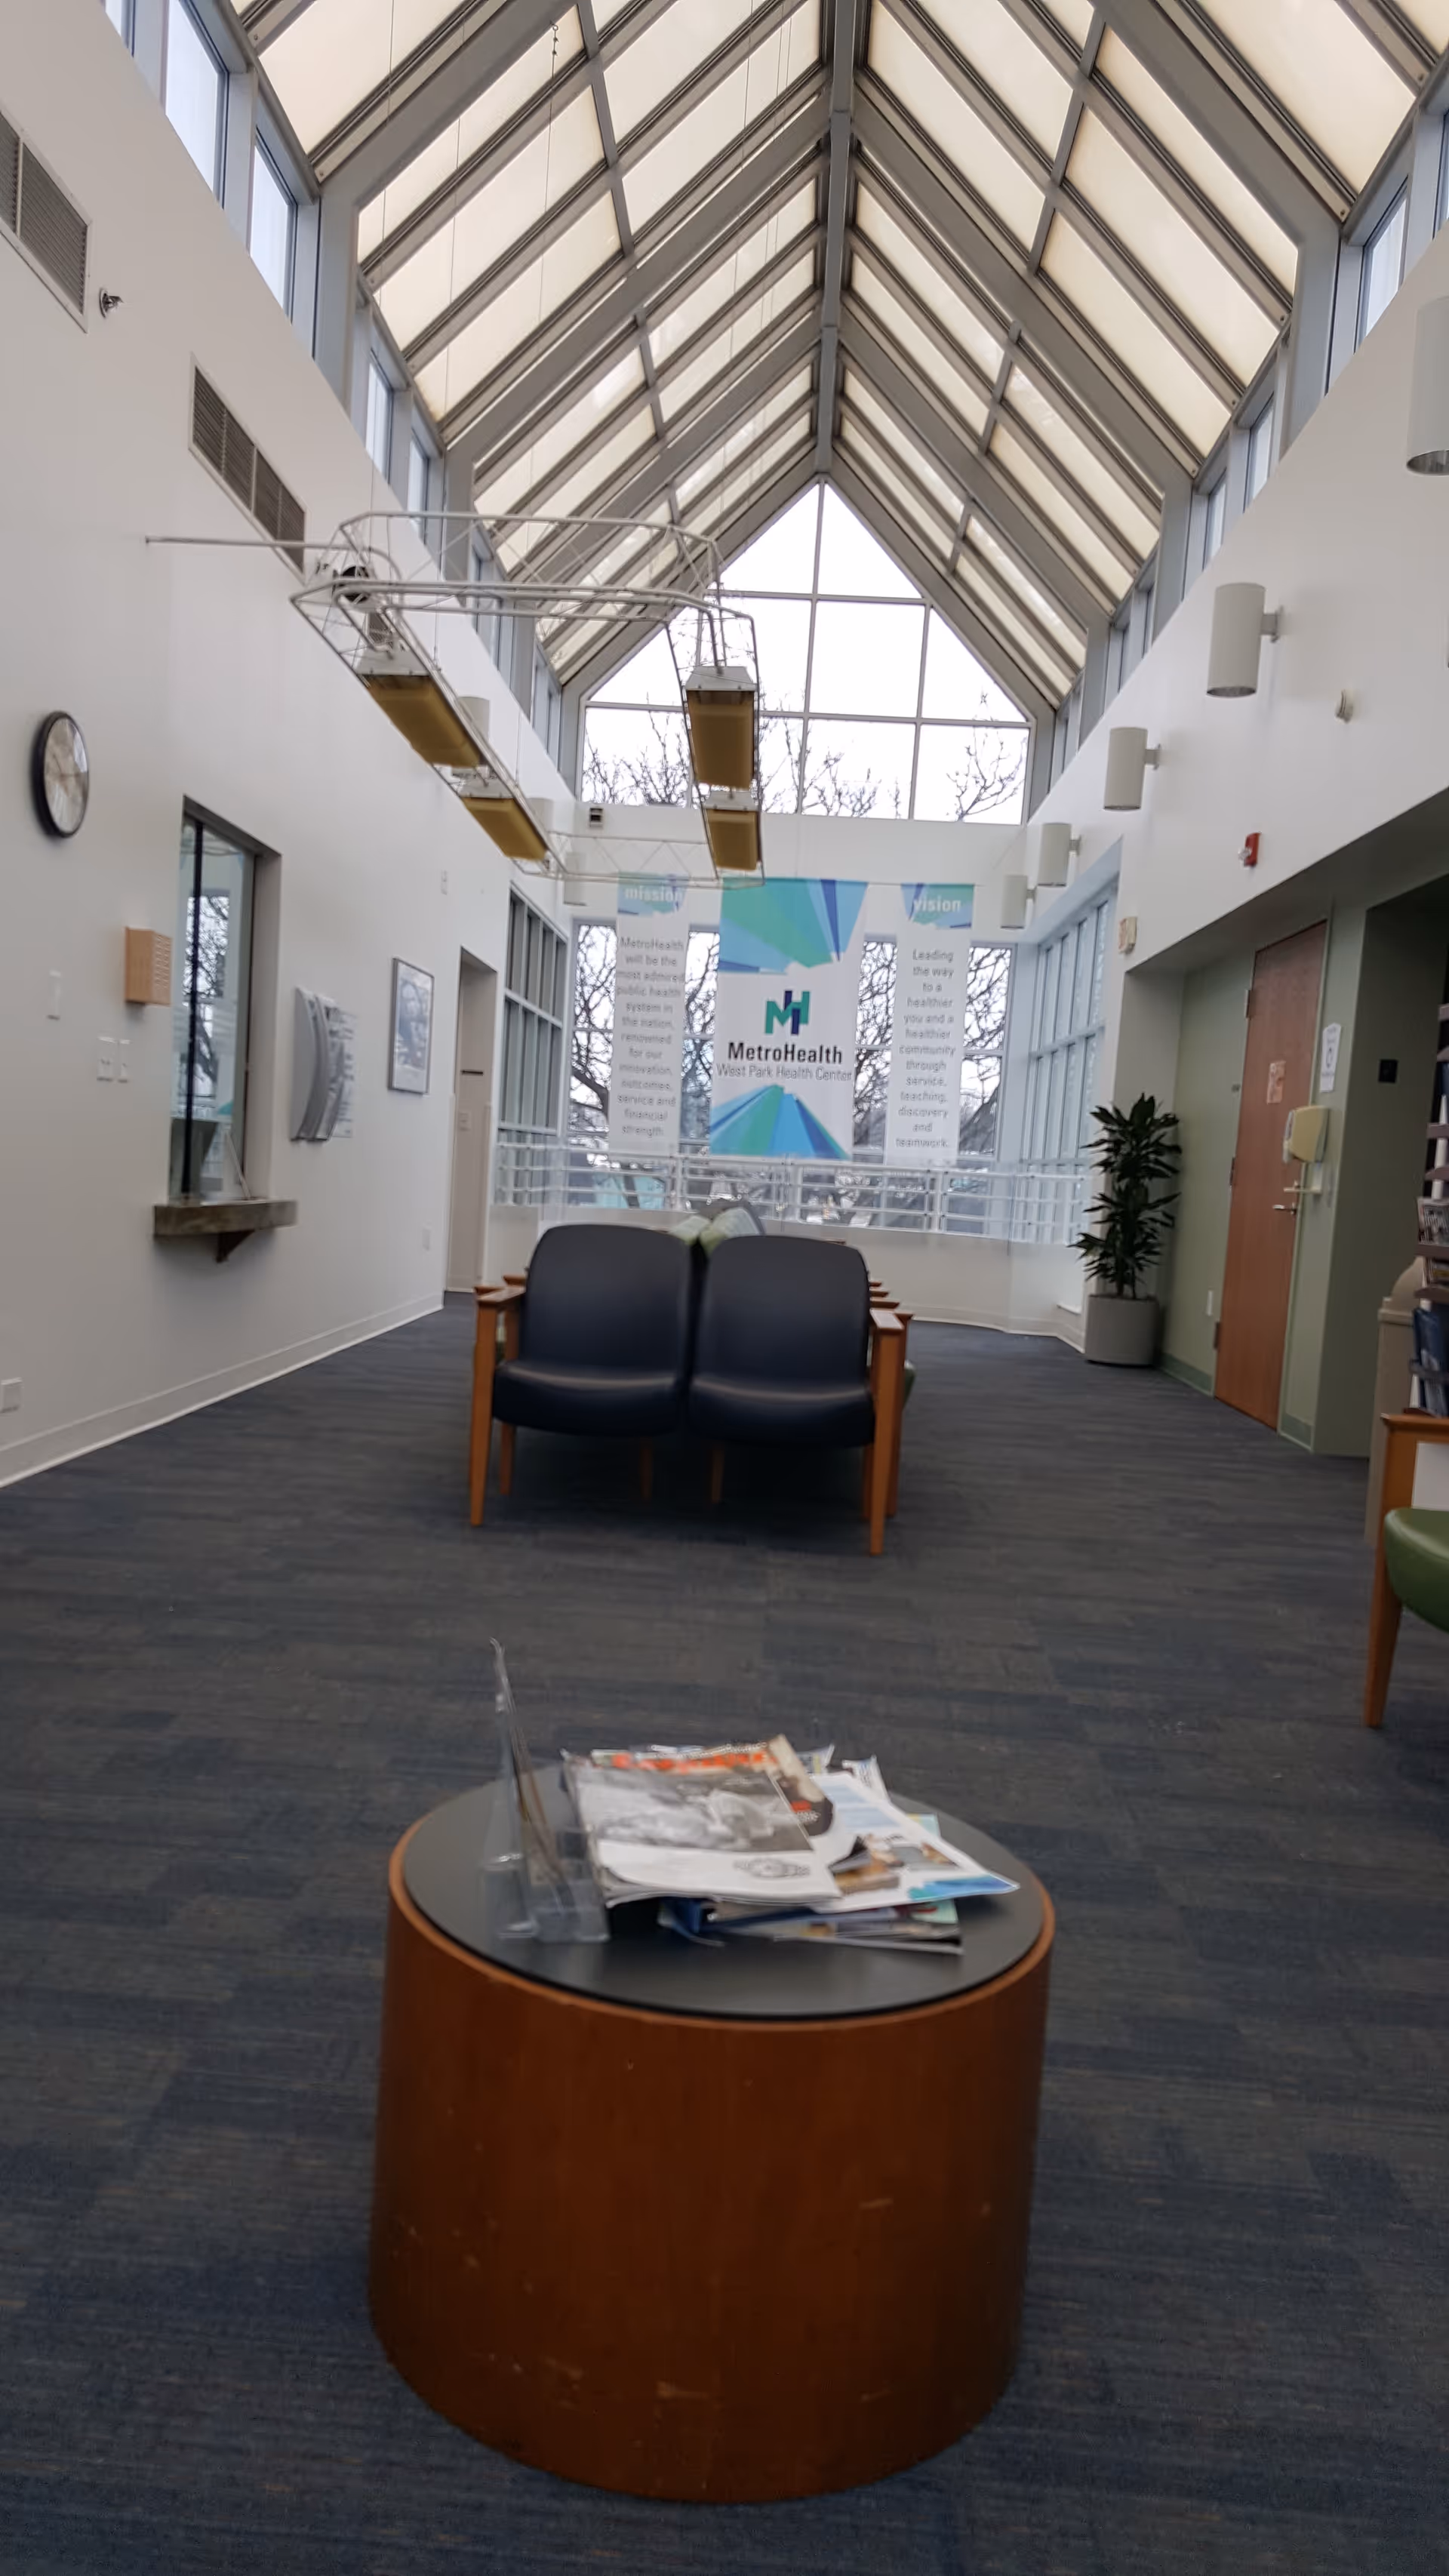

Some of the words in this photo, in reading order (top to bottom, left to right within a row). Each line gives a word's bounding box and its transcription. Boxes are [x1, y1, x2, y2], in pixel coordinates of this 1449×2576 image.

[624, 885, 683, 903] mission
[914, 895, 961, 912] vision
[620, 937, 684, 951] MetroHealth
[626, 954, 643, 965] will
[645, 955, 658, 966] be
[660, 956, 677, 967] the
[912, 949, 954, 963] Leading
[913, 966, 930, 977] the
[931, 968, 955, 980] way
[649, 986, 681, 998] health
[922, 982, 934, 993] to
[907, 996, 952, 1008] healthier
[903, 1014, 923, 1026] you
[926, 1014, 946, 1025] and
[728, 1042, 842, 1063] MetroHealth
[717, 1063, 745, 1078] West
[749, 1065, 773, 1079] Park
[776, 1066, 813, 1081] Health
[815, 1068, 852, 1082] Center
[912, 1123, 933, 1133] and
